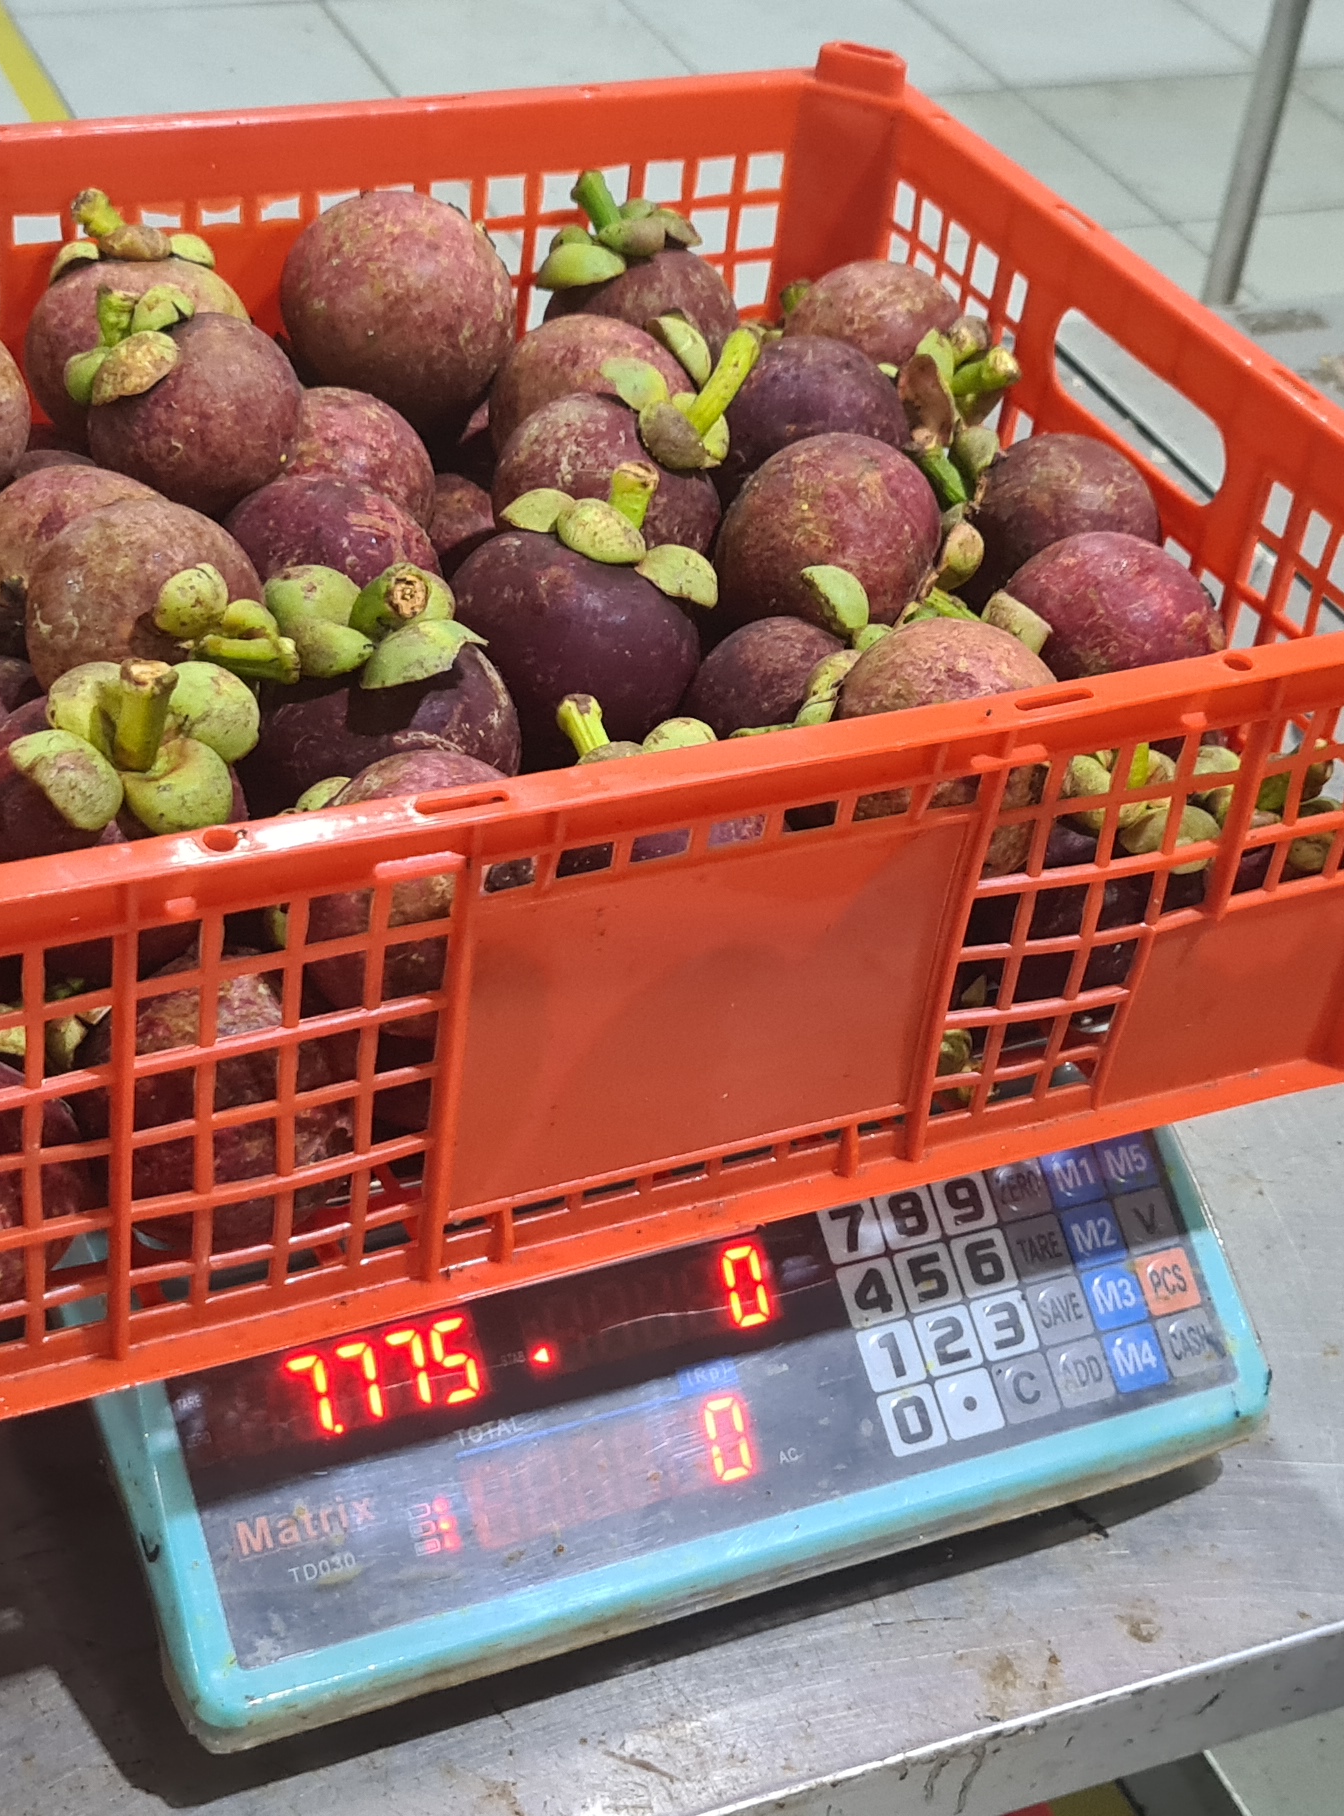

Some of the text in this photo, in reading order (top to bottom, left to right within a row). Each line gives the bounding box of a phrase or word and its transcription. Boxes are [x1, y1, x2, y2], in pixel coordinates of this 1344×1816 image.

[1051, 1156, 1096, 1193] M1
[1104, 1143, 1148, 1182] M5
[828, 1177, 986, 1254] 7 8 9
[1069, 1215, 1117, 1254] M2
[1015, 1231, 1064, 1265] TARE
[721, 1245, 771, 1328] 0
[853, 1238, 1006, 1314] 4 5 6
[1149, 1263, 1188, 1296] PCS
[1036, 1291, 1084, 1329] SAVE
[1091, 1277, 1136, 1316] M3
[877, 1300, 1026, 1379] 1 2 3
[1111, 1338, 1158, 1377] M4
[1168, 1322, 1212, 1361] CASH
[1011, 1370, 1042, 1405] C
[1060, 1355, 1104, 1390] ADD
[456, 1416, 525, 1447] TOTAL
[703, 1396, 753, 1481] 0
[890, 1394, 934, 1445] 0
[778, 1446, 800, 1464] AC
[234, 1496, 376, 1556] Matrix
